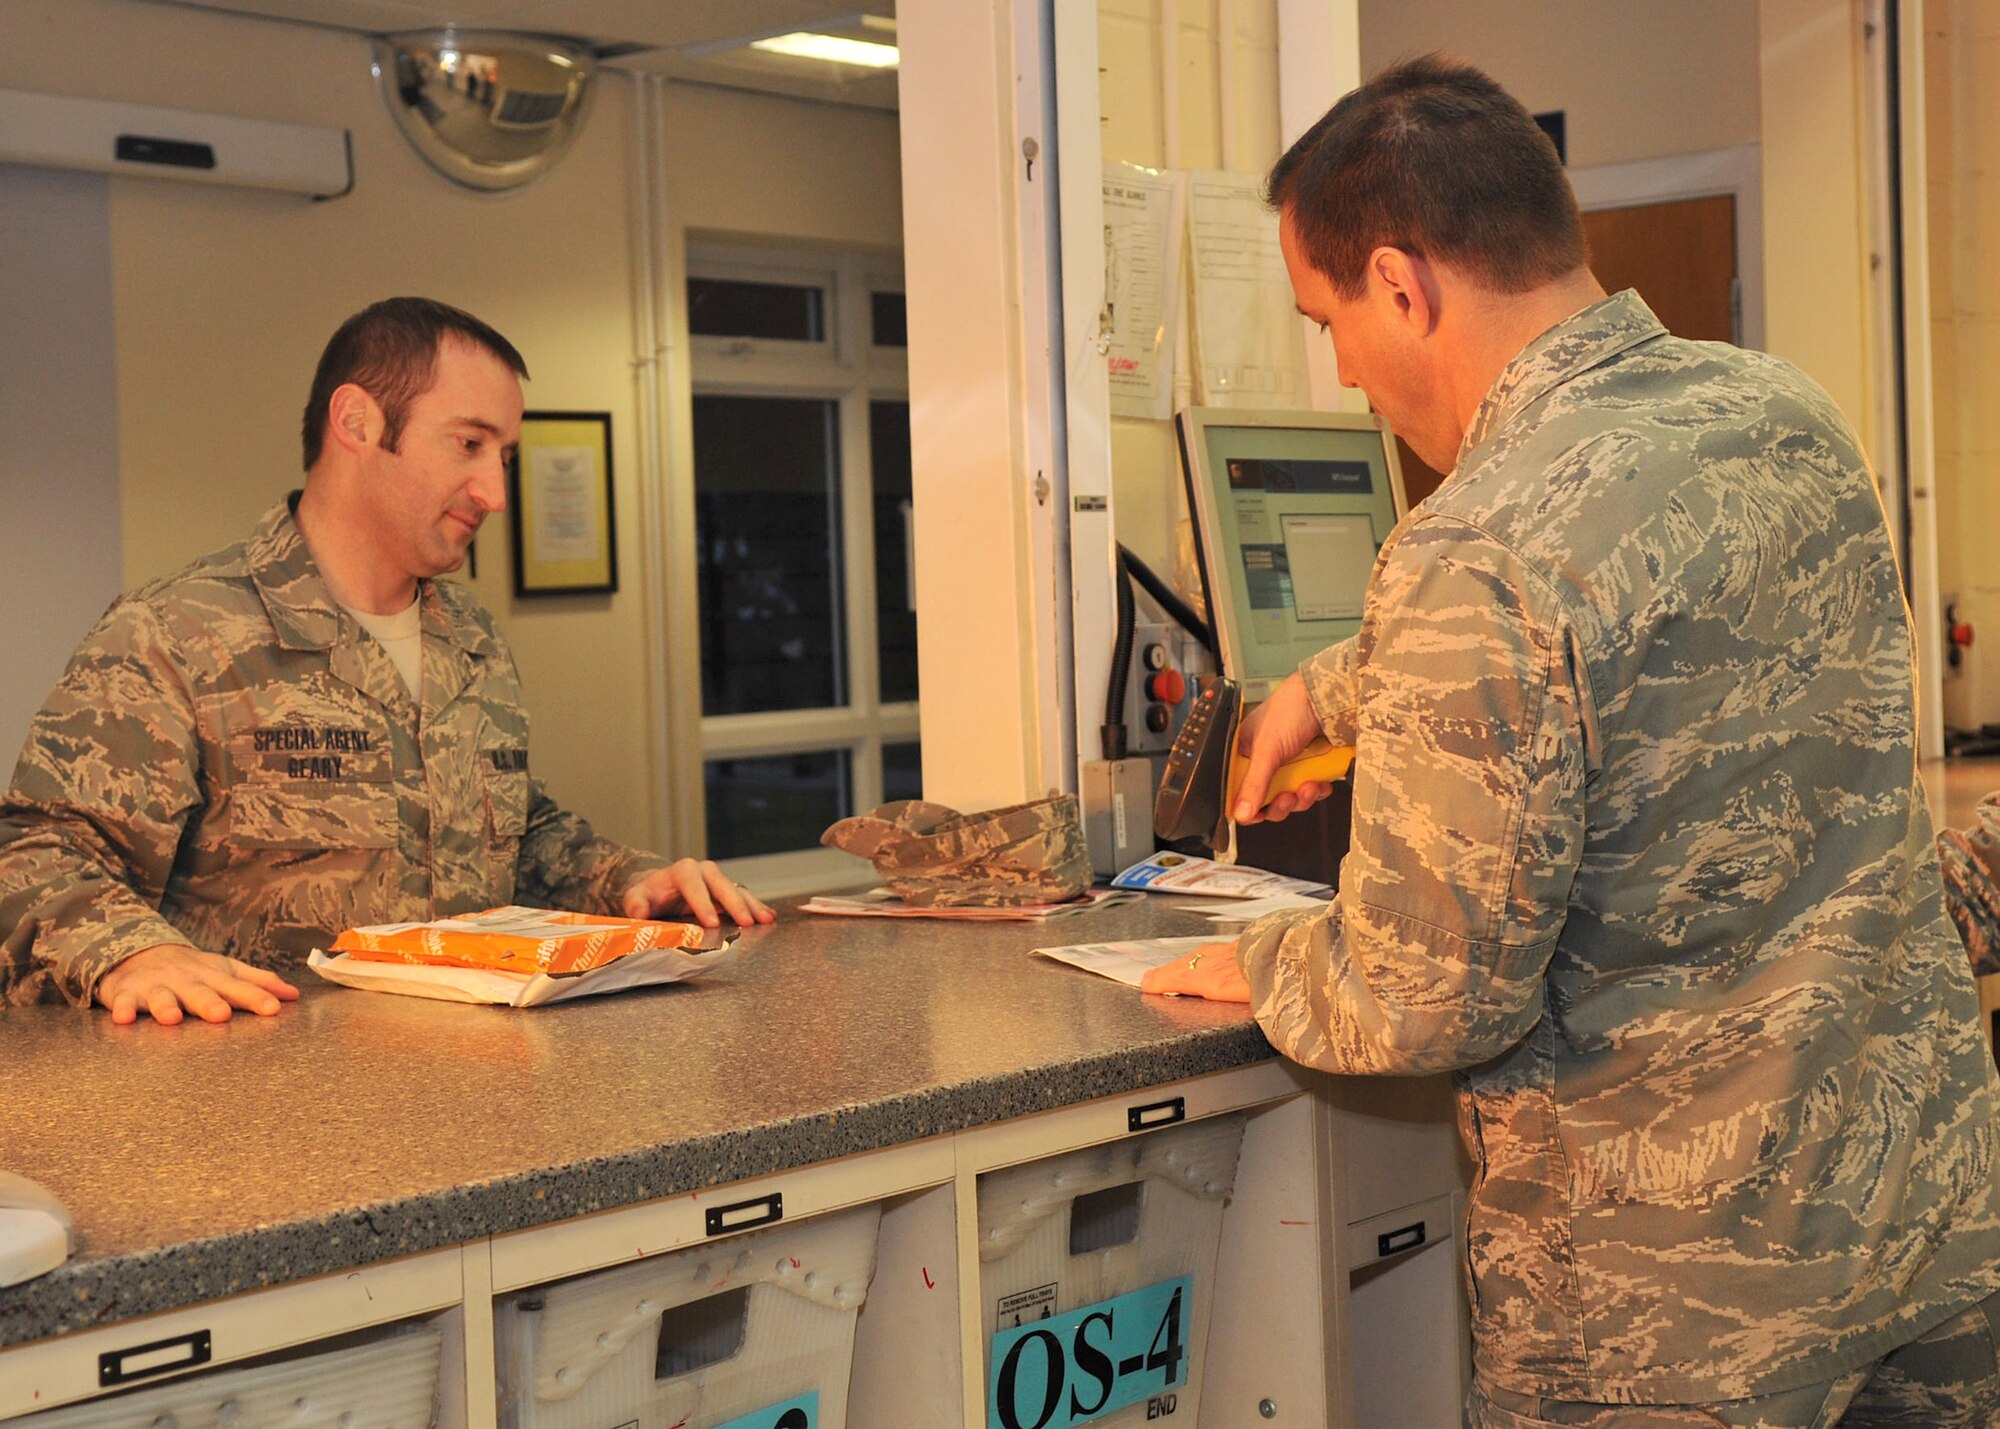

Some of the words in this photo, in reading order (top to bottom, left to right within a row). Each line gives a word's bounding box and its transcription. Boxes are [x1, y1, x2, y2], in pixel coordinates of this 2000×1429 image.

[253, 727, 319, 752] SPECIAL
[325, 728, 370, 751] AGENT
[287, 756, 342, 779] GEARY
[996, 1286, 1183, 1429] OS-4
[1147, 1394, 1177, 1420] END
